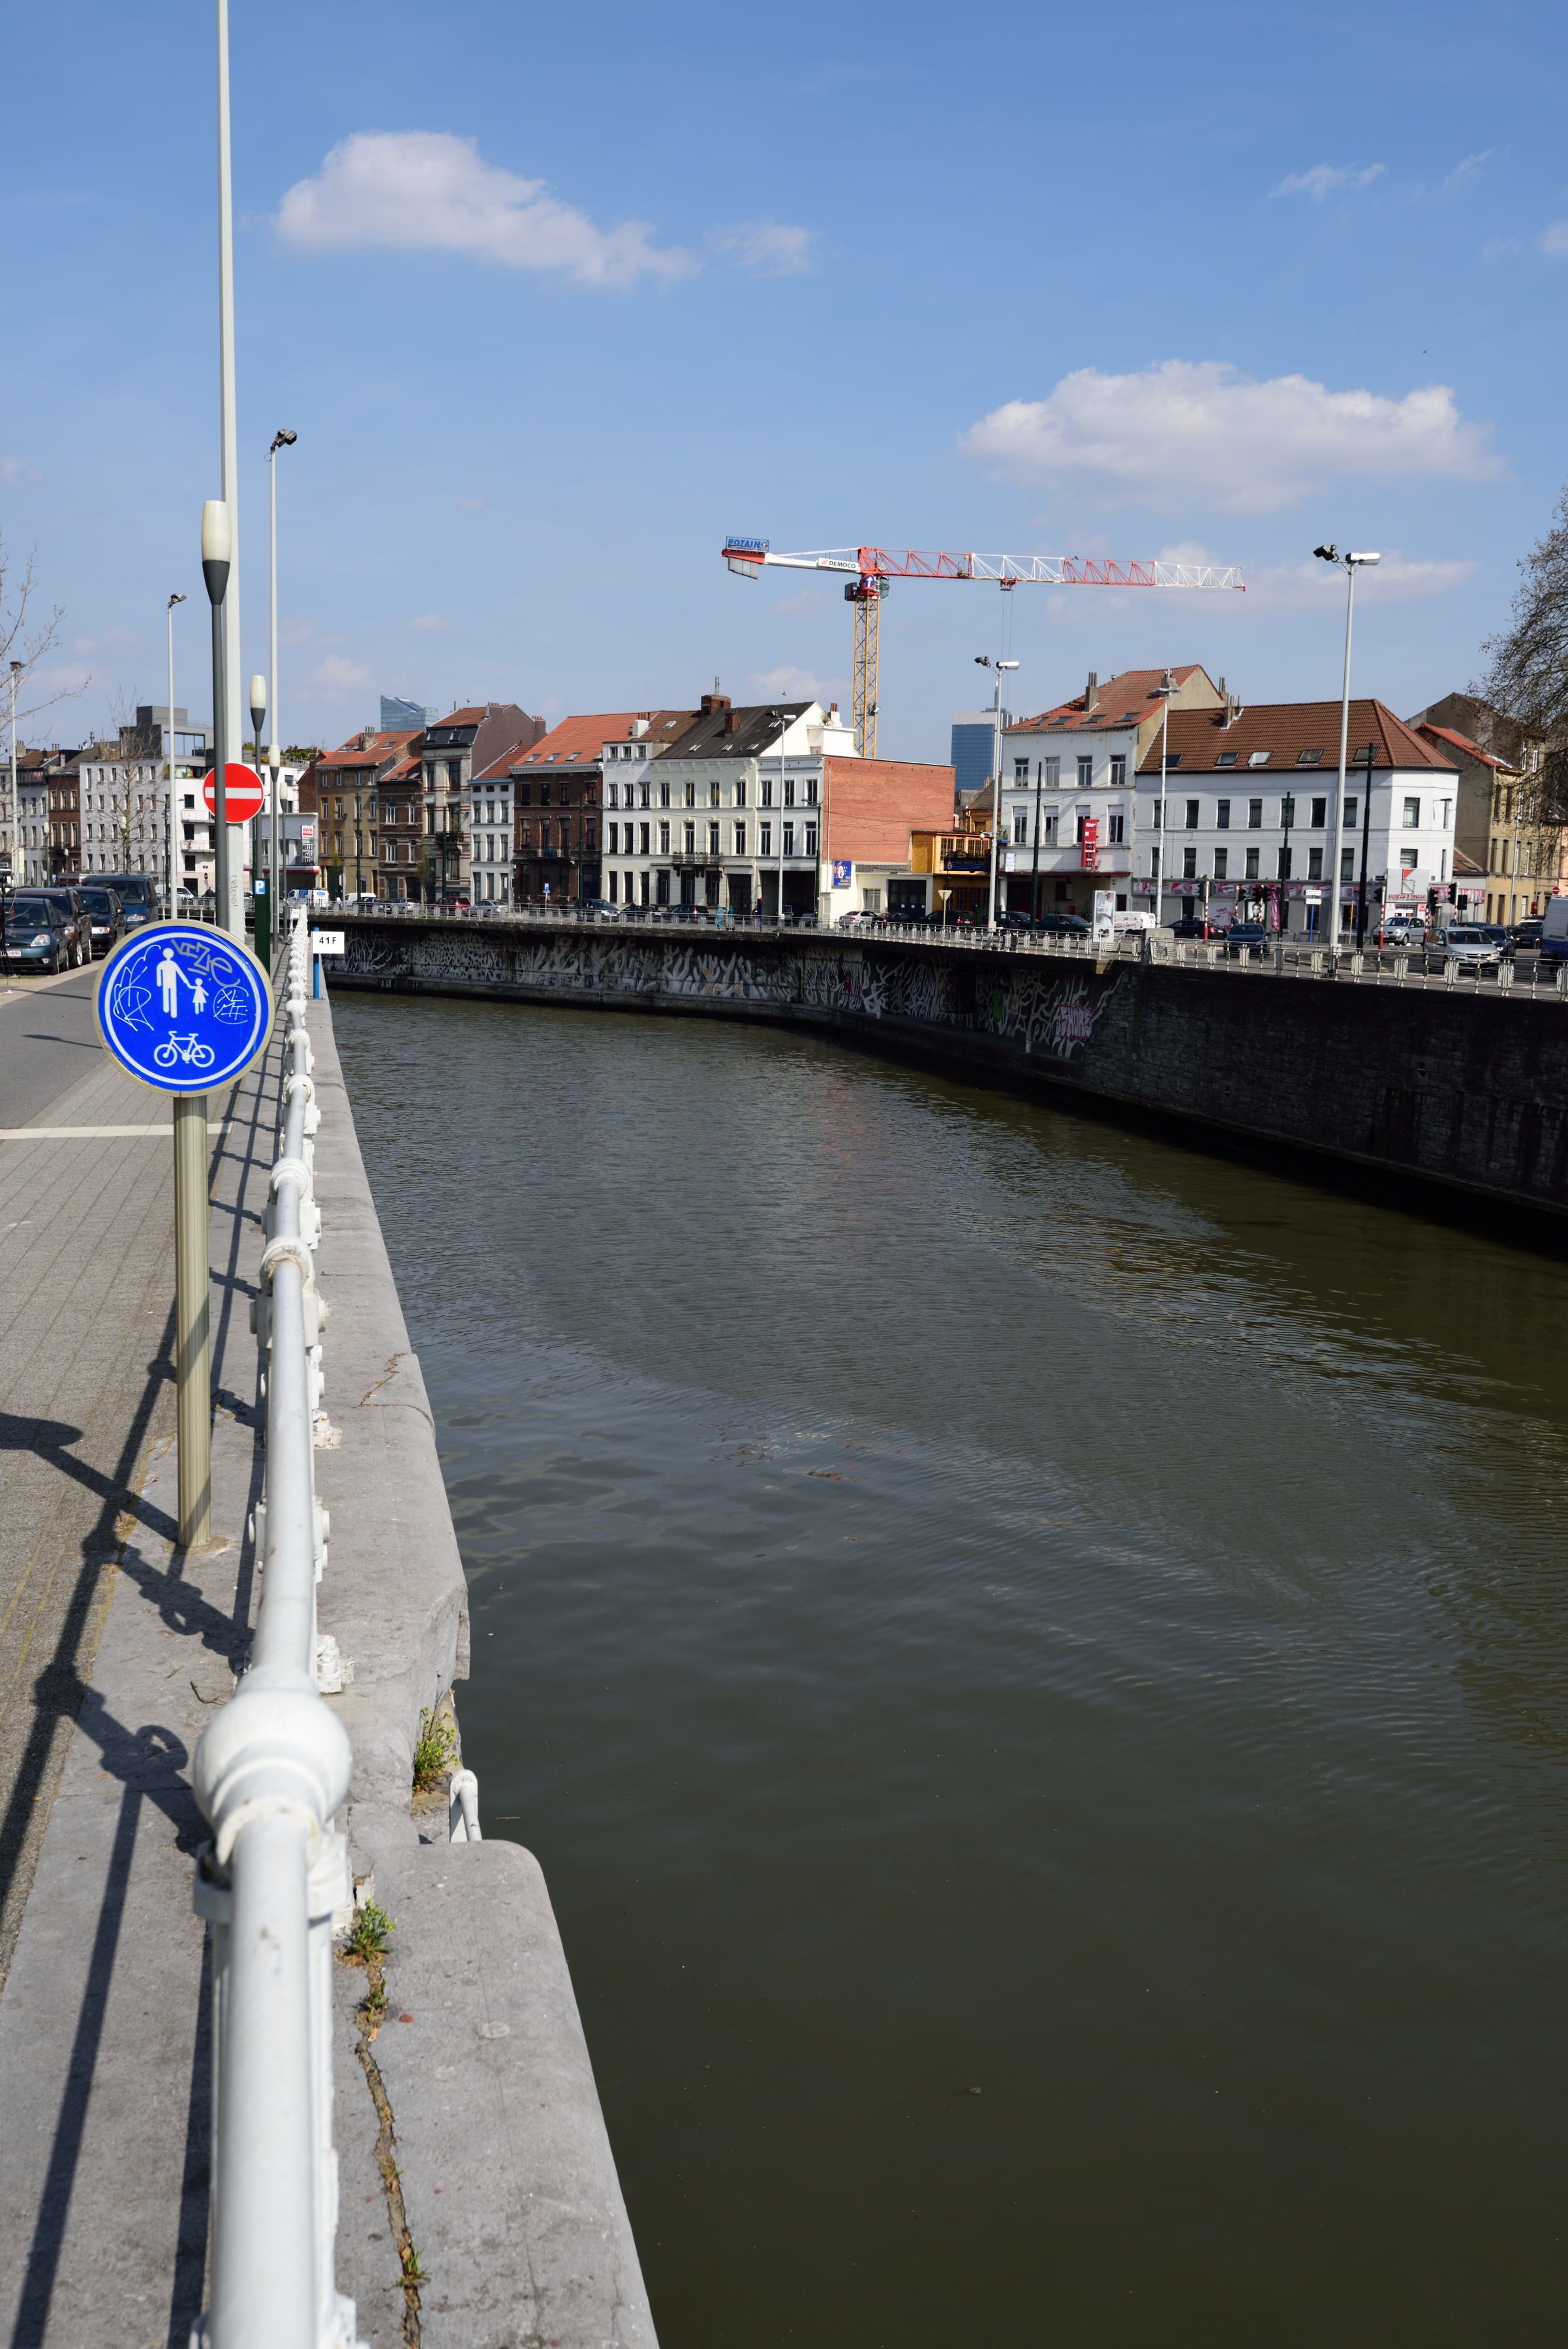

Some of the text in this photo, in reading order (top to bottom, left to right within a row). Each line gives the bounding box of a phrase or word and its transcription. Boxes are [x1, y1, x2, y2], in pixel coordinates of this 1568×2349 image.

[728, 538, 761, 549] POTAIN
[829, 560, 856, 569] DEMOCO
[255, 880, 264, 893] P
